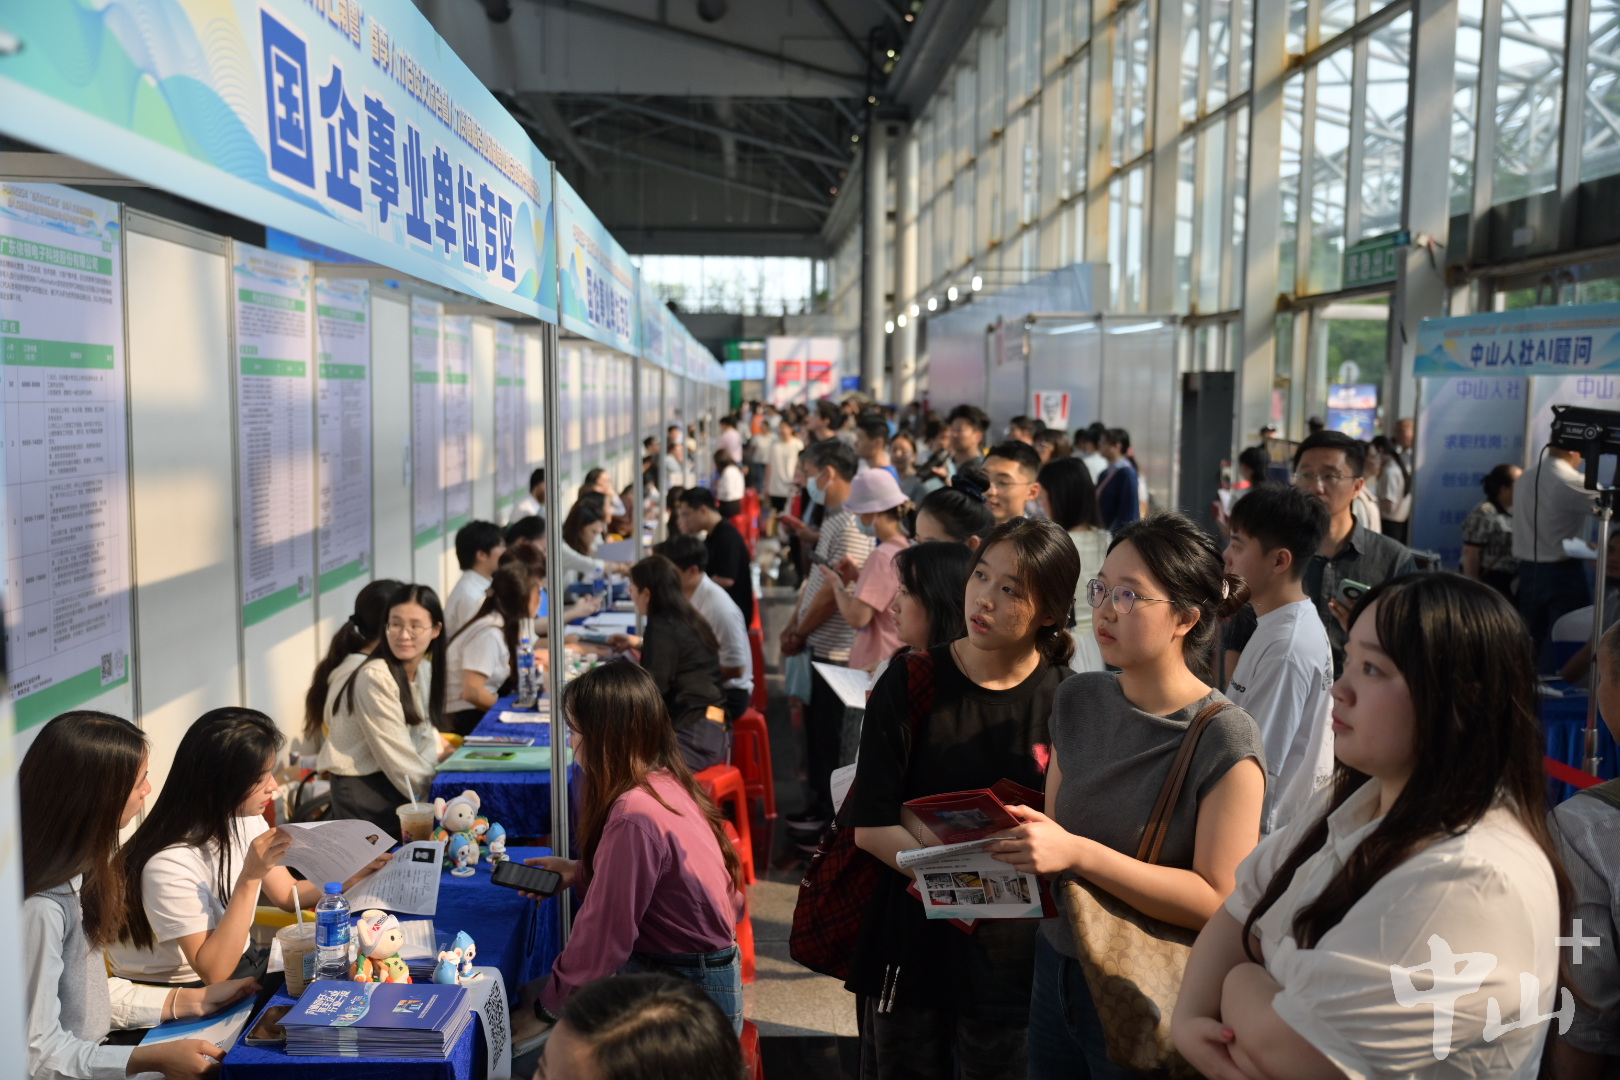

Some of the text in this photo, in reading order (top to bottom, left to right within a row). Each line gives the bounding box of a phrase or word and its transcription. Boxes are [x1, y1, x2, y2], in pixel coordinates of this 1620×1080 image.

[259, 6, 516, 284] 国企事业单位专区
[1470, 336, 1593, 367] 中山人社AI顾问
[1456, 379, 1521, 400] 中山人社
[1576, 375, 1620, 400] 中山
